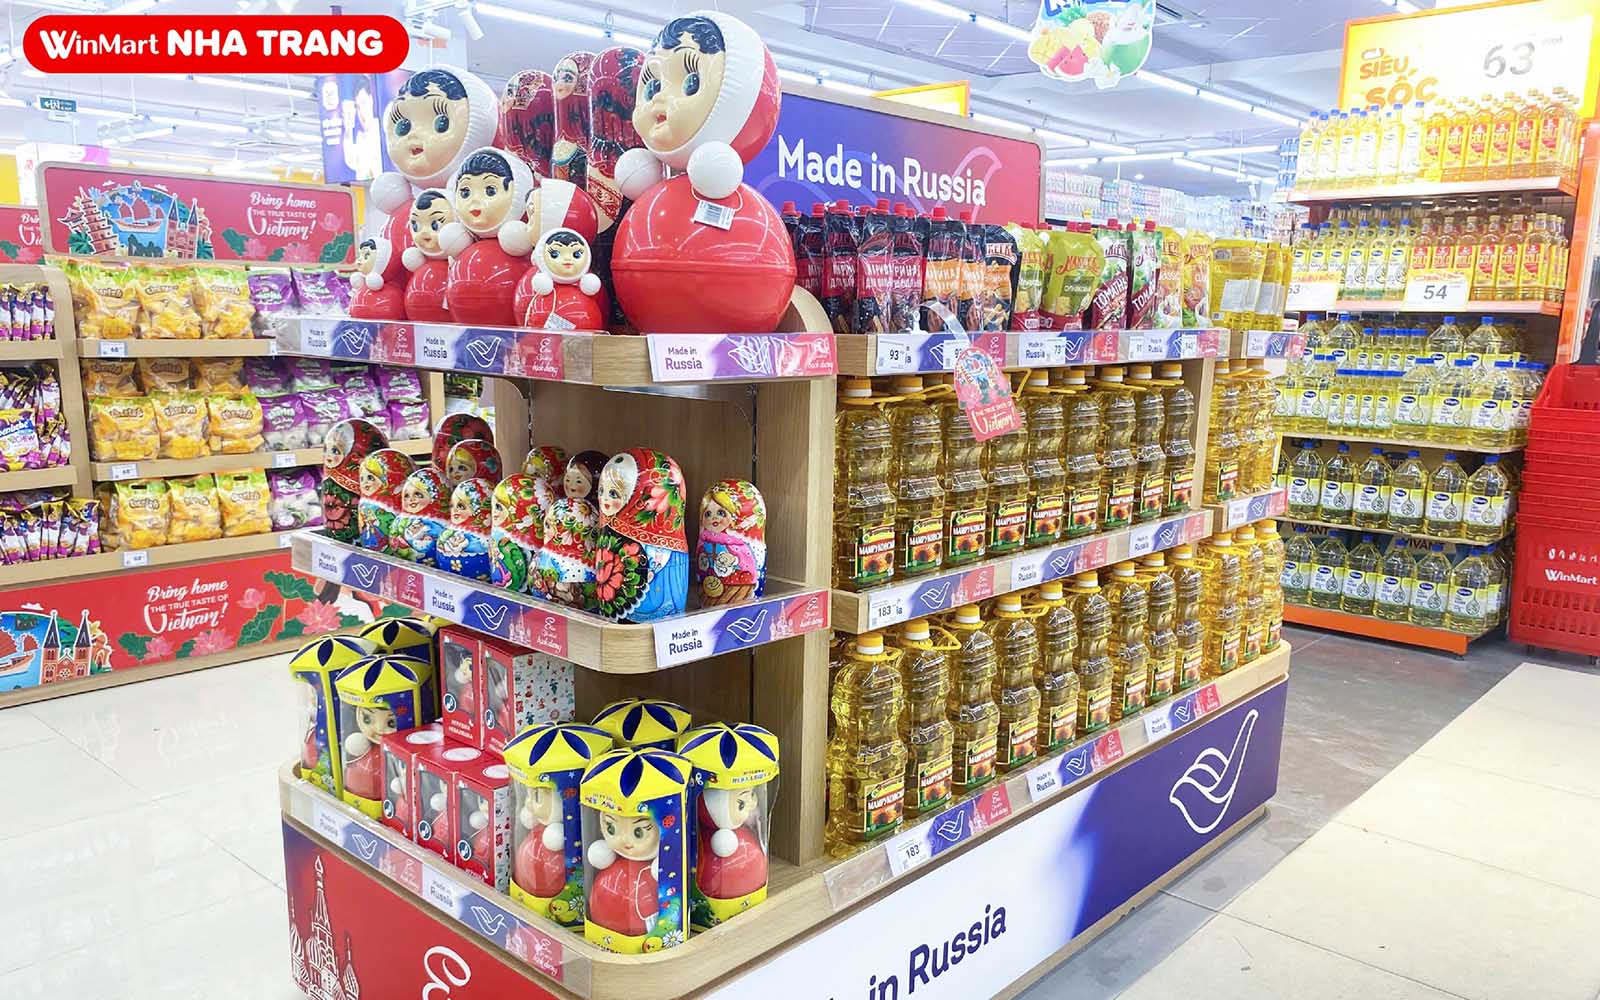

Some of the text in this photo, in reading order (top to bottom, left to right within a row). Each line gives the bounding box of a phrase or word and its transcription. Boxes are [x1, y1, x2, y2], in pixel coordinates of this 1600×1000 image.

[777, 134, 987, 206] Made in Russia
[250, 191, 318, 210] Bring home
[1423, 284, 1448, 300] 54
[425, 336, 439, 346] Made
[423, 346, 448, 360] Russia
[667, 345, 698, 355] Made in
[889, 350, 900, 361] 93
[1025, 349, 1046, 359] Russia
[665, 357, 703, 371] Russia
[319, 558, 338, 573] Russia
[1018, 571, 1037, 583] Russia
[1544, 568, 1599, 585] WinMart
[147, 578, 229, 603] Bring home
[434, 588, 448, 599] Made
[150, 593, 230, 613] THE TRUE TASTE OF
[432, 597, 455, 613] Russia
[878, 605, 892, 617] 183
[671, 628, 699, 642] Made in
[669, 638, 703, 656] Russia
[1036, 778, 1056, 793] Russia
[905, 844, 920, 858] 183
[430, 886, 454, 908] Russia
[869, 903, 1007, 1000] in Russia
